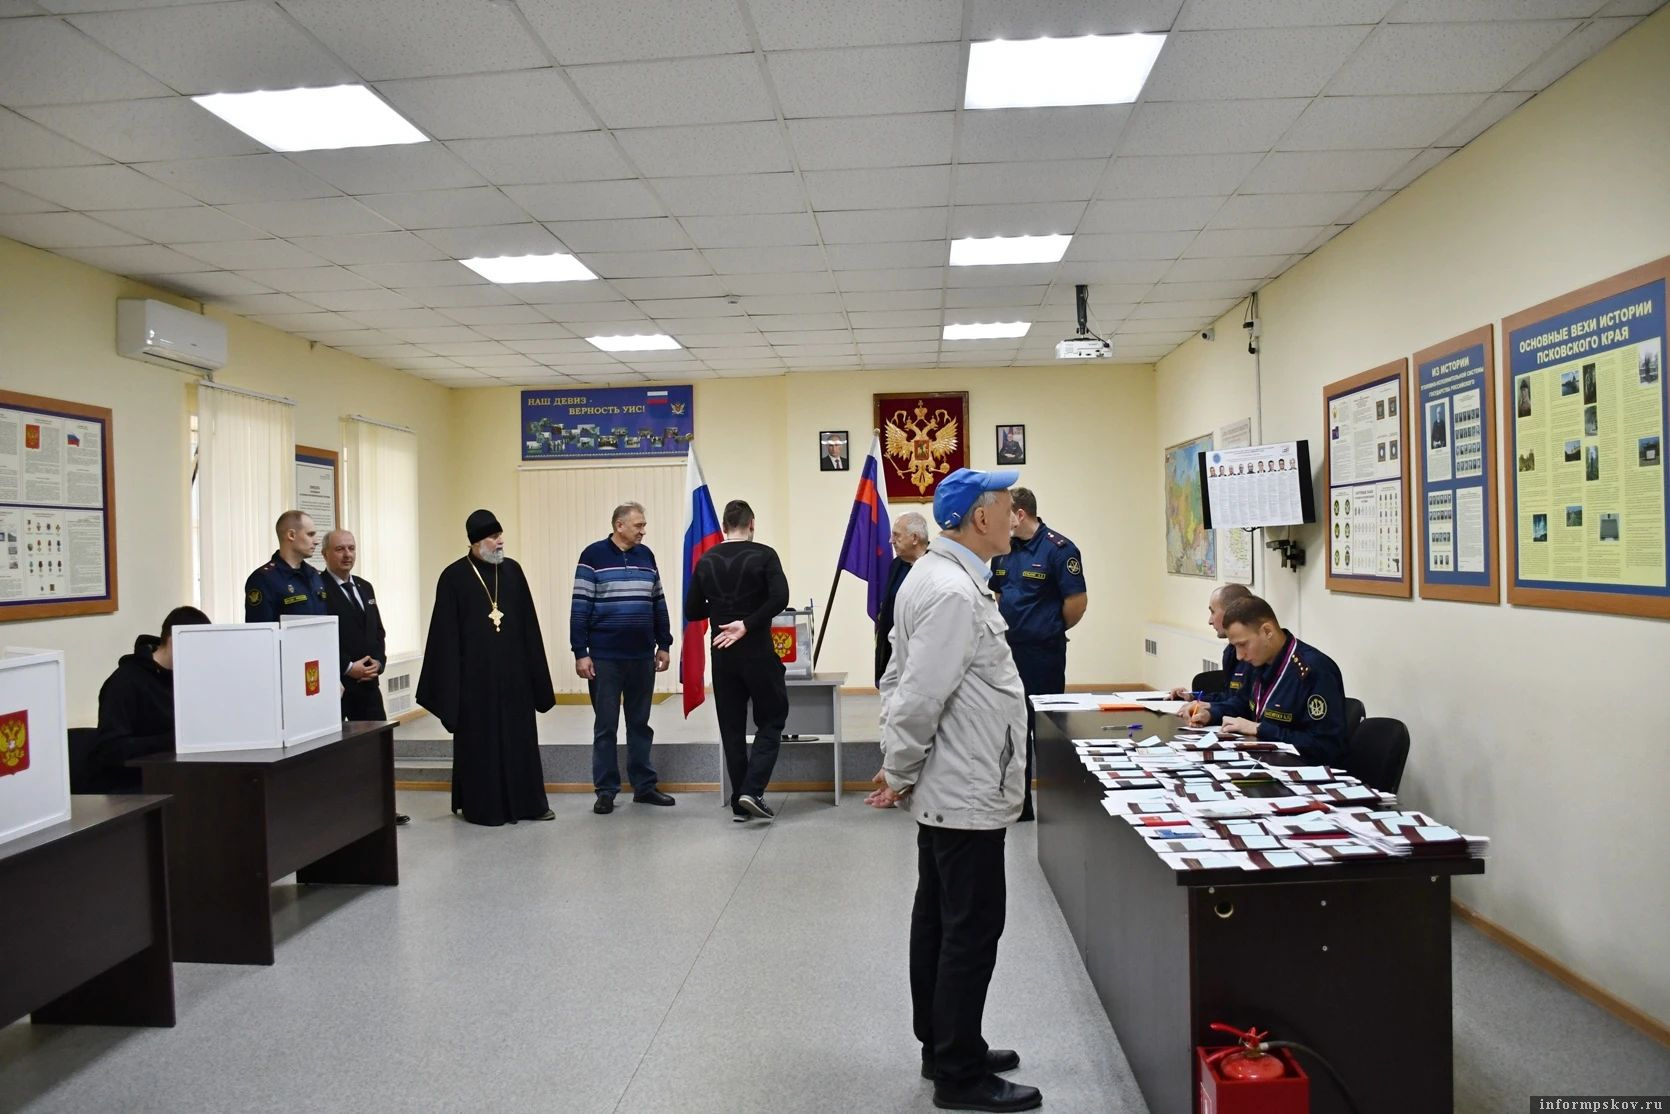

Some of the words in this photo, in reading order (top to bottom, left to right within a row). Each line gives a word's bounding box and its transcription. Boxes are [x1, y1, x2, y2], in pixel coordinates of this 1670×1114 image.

[1519, 327, 1569, 353] ОСНОВНЫЕ
[1570, 318, 1597, 337] ВЕХИ
[1599, 300, 1653, 328] ИСТОРИИ
[1537, 335, 1599, 364] ПСКОВСКОГО
[1601, 326, 1630, 346] КРАЯ
[1432, 366, 1440, 377] ИЗ
[1440, 356, 1470, 374] ИСТОРИИ
[528, 398, 550, 406] НАШ
[553, 396, 587, 406] ДЕВИЗ
[569, 406, 620, 415] ВЕРНОСТЬ
[623, 404, 646, 413] УИС!
